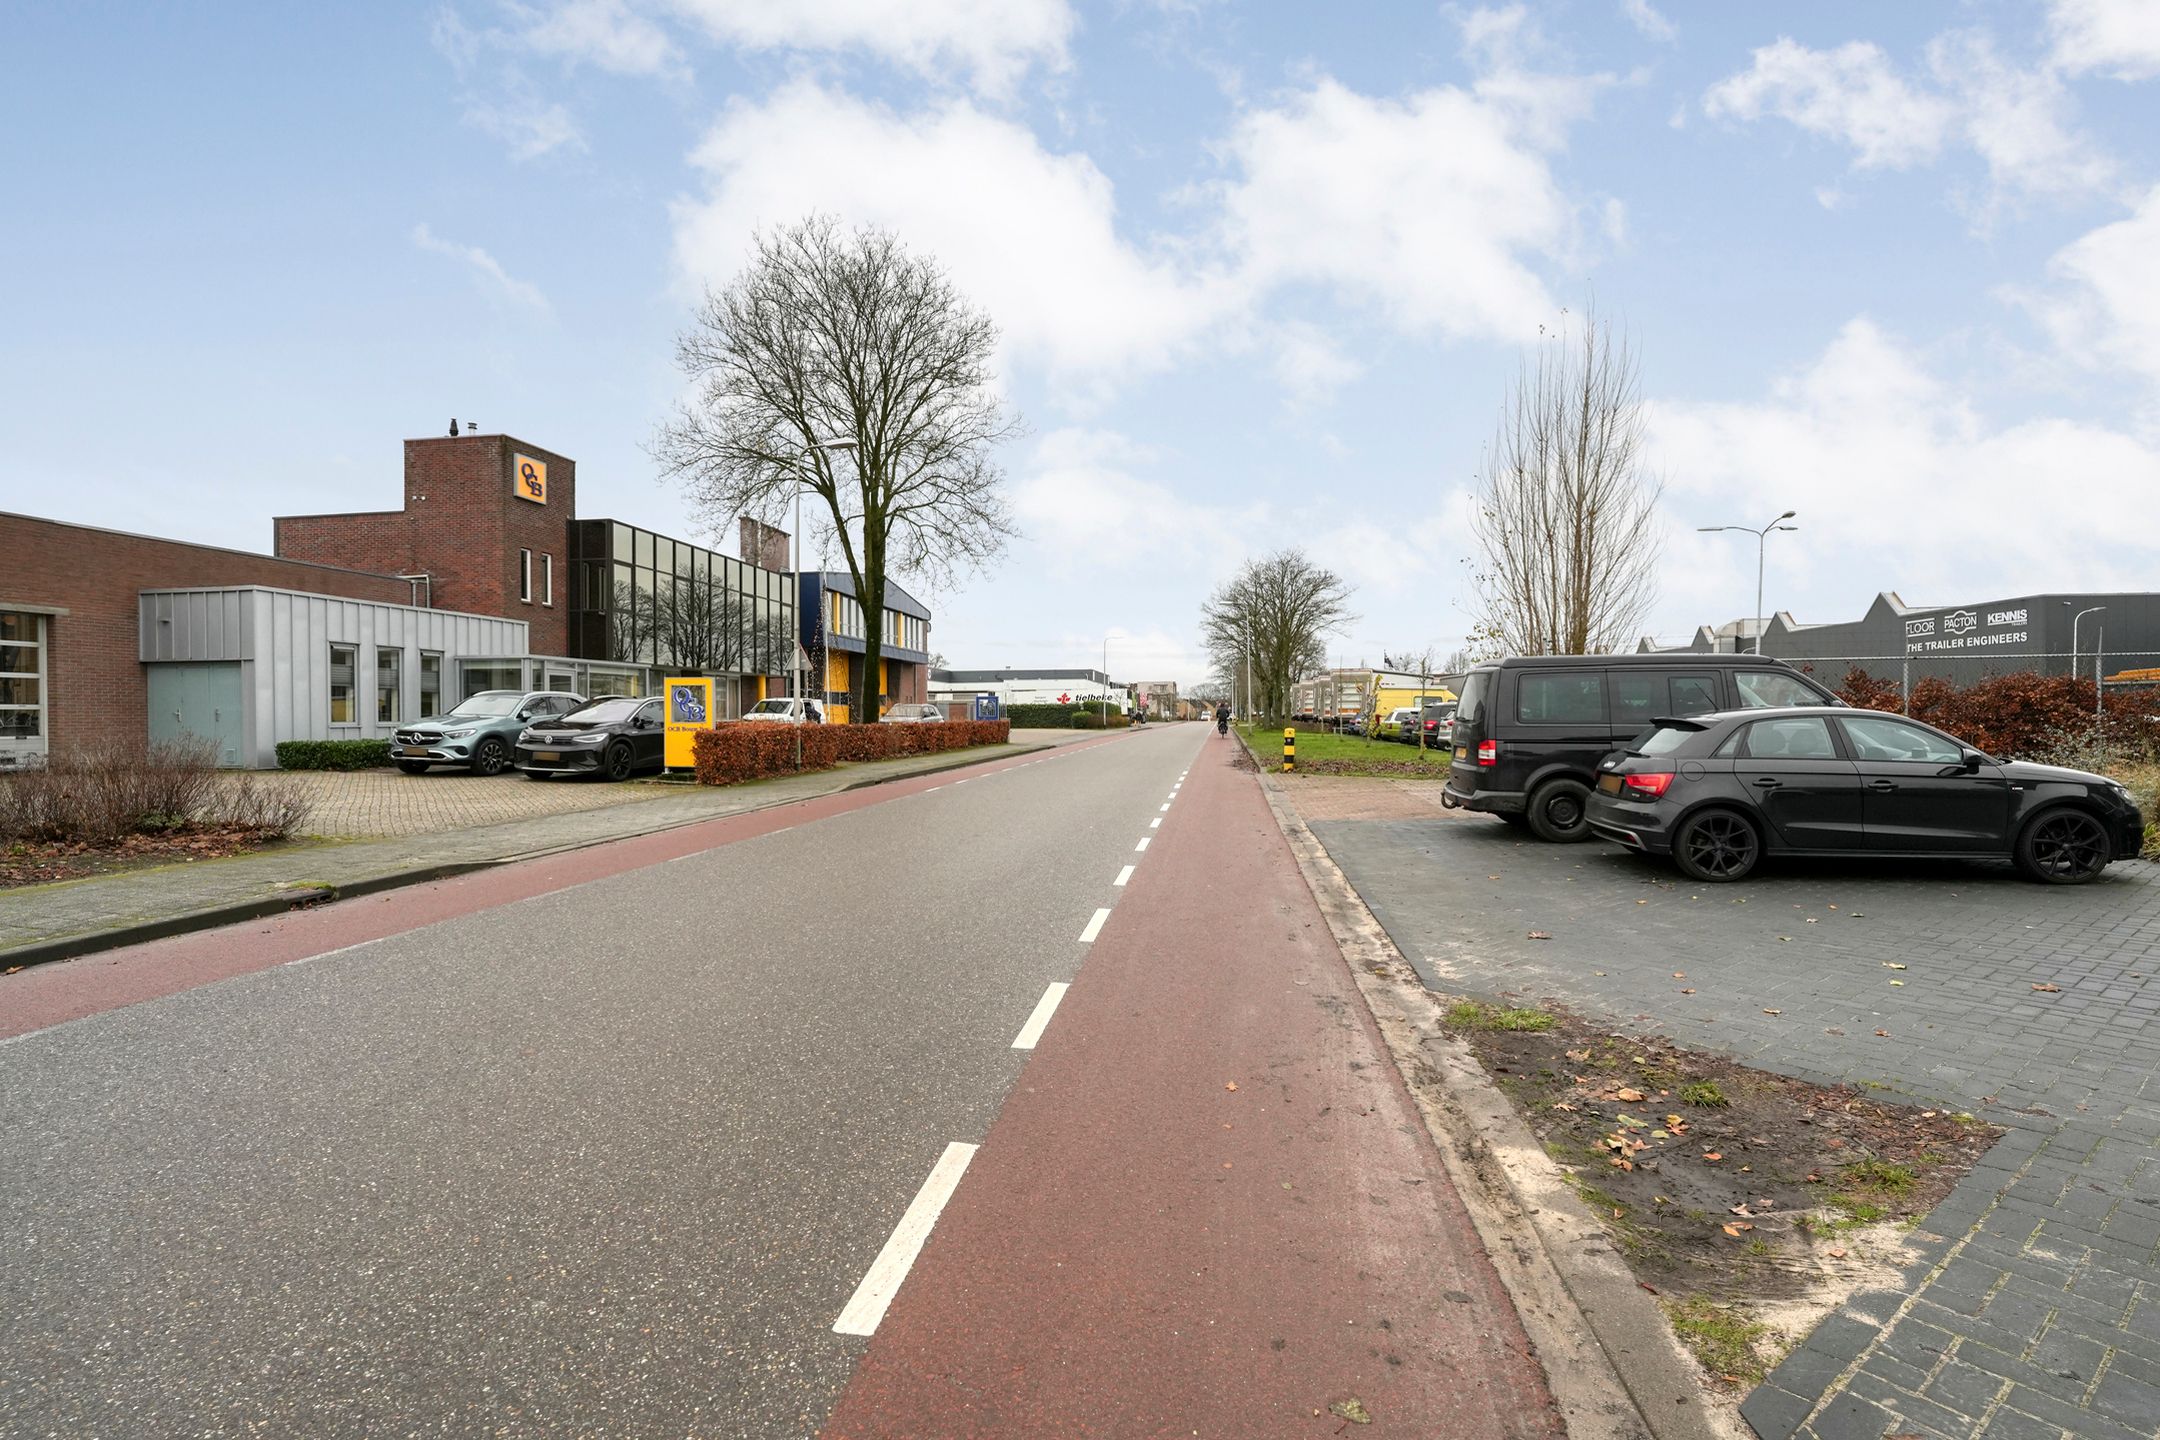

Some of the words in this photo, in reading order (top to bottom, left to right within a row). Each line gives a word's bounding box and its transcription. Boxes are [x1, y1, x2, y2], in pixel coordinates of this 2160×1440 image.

[1944, 616, 1977, 629] PACTON
[1987, 609, 2028, 623] KENNIS
[1906, 621, 1935, 634] FLOOR
[1907, 643, 1923, 652] THE
[1925, 639, 1965, 650] TRAILER
[1967, 632, 2028, 647] ENGINEERS
[1075, 692, 1113, 702] tielbeke
